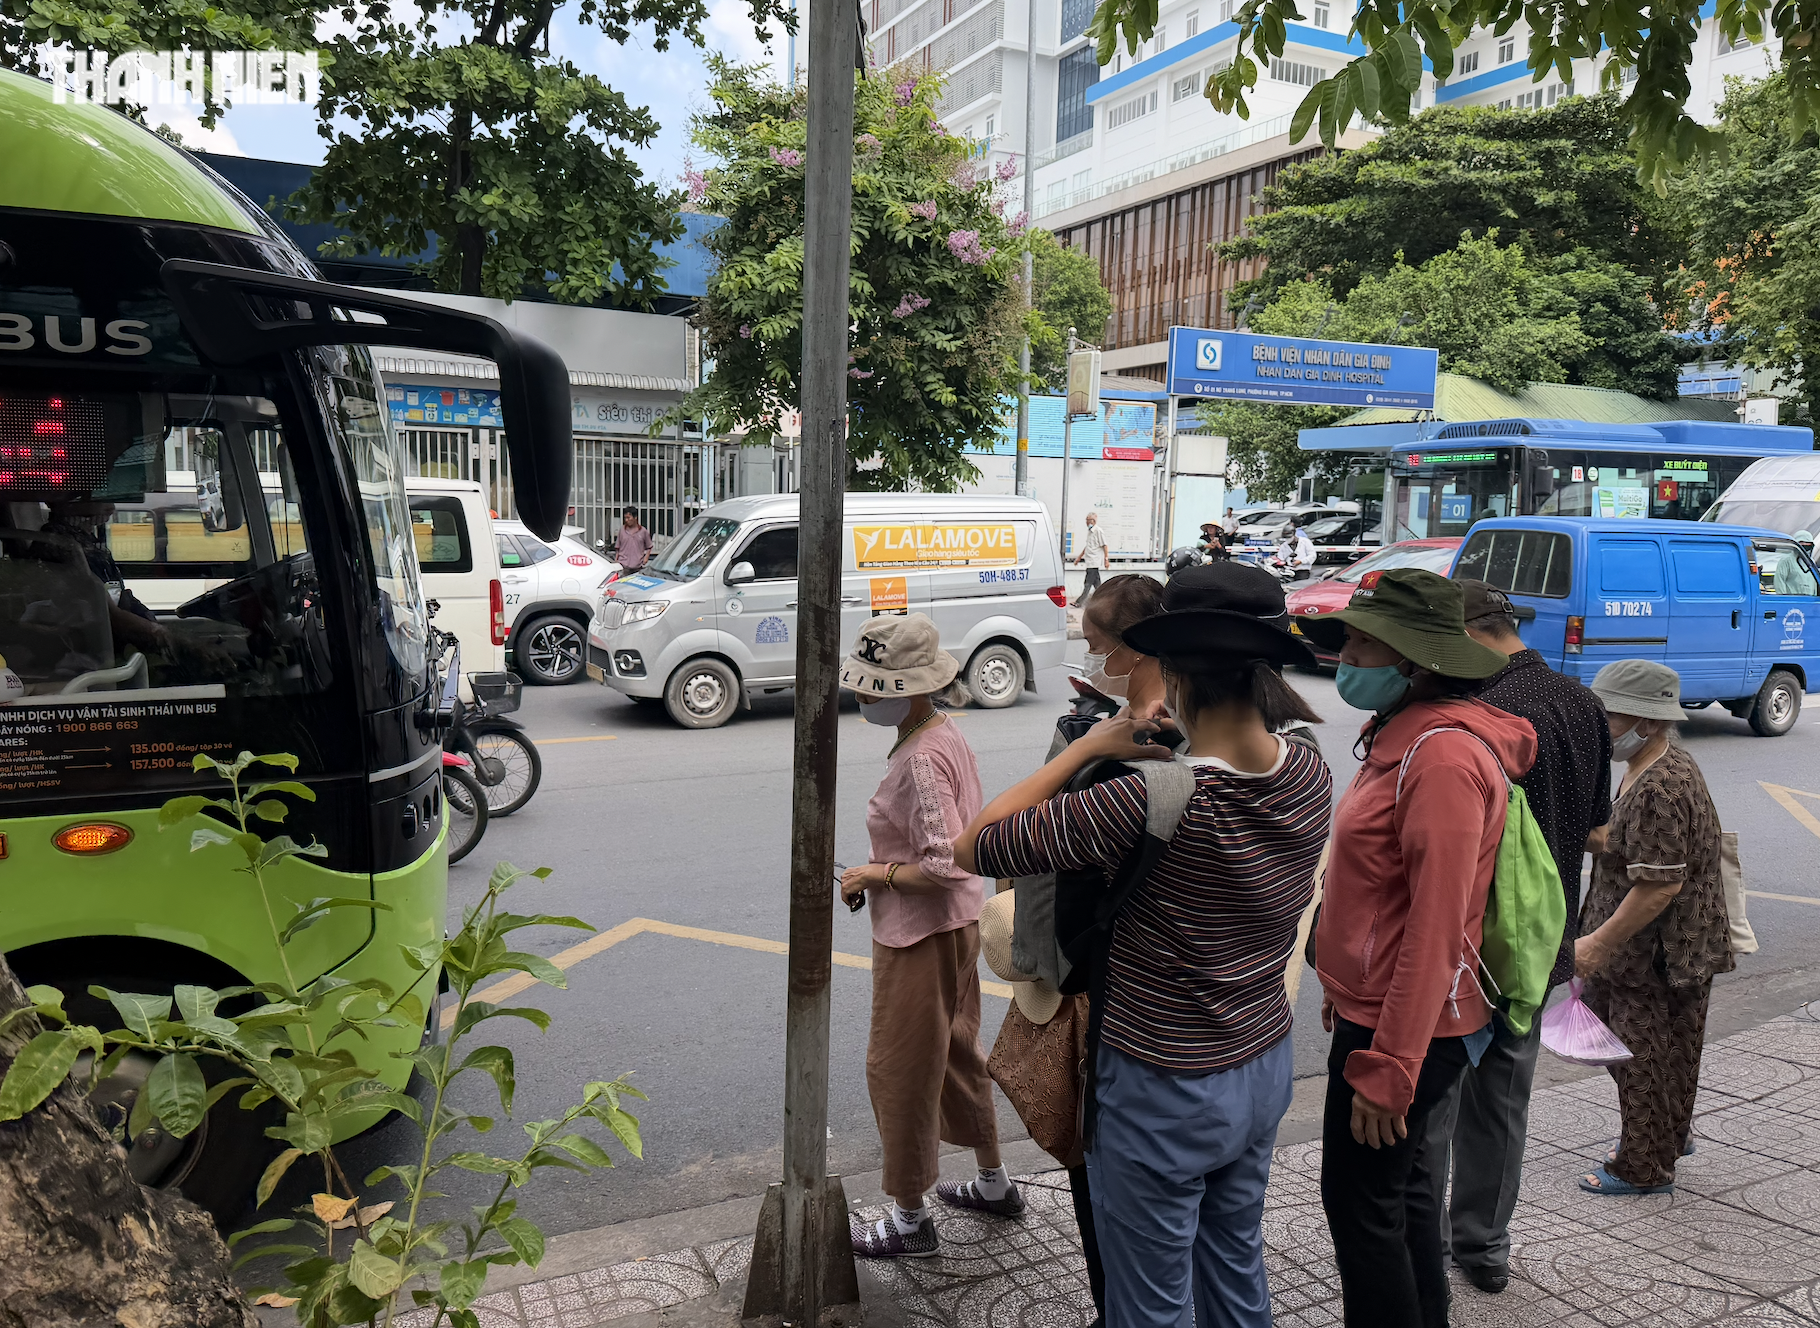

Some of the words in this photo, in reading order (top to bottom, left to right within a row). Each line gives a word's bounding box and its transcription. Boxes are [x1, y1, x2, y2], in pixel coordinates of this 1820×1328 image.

[0, 312, 153, 356] BUS
[1253, 343, 1278, 363] BỆNH
[1281, 345, 1301, 365] VIỆN
[1304, 348, 1330, 366] NHÂN
[1333, 349, 1352, 367] DÂN
[1354, 353, 1369, 368] GIA
[1371, 354, 1391, 371] ĐỊNH
[1256, 366, 1281, 378] NHAN
[1284, 367, 1302, 379] DAN
[1305, 369, 1320, 380] GIA
[1346, 371, 1385, 384] HOSPITAL
[597, 401, 628, 421] Siêu
[631, 406, 652, 426] thị
[1663, 460, 1673, 469] XE
[1574, 469, 1582, 479] 18
[1618, 494, 1642, 503] MultiGo
[1452, 504, 1465, 516] 01
[884, 528, 1013, 549] LALAMOVE
[916, 549, 933, 558] Giao
[934, 549, 952, 560] hàng
[968, 548, 979, 557] tốc
[979, 569, 1030, 584] 50H-488.57
[505, 594, 521, 605] 27
[872, 593, 906, 602] LALAMOVE
[1605, 601, 1621, 616] 51D
[28, 710, 55, 723] DỊCH
[57, 709, 74, 721] VỤ
[76, 706, 99, 721] VẬN
[120, 706, 146, 717] SINH
[148, 703, 174, 715] THÁI
[175, 705, 194, 715] VIN
[196, 703, 217, 714] BUS
[56, 723, 86, 733] 1900
[90, 721, 113, 732] 866
[116, 720, 138, 731] 663
[130, 742, 175, 755] 135.000
[130, 757, 175, 770] 157.500
